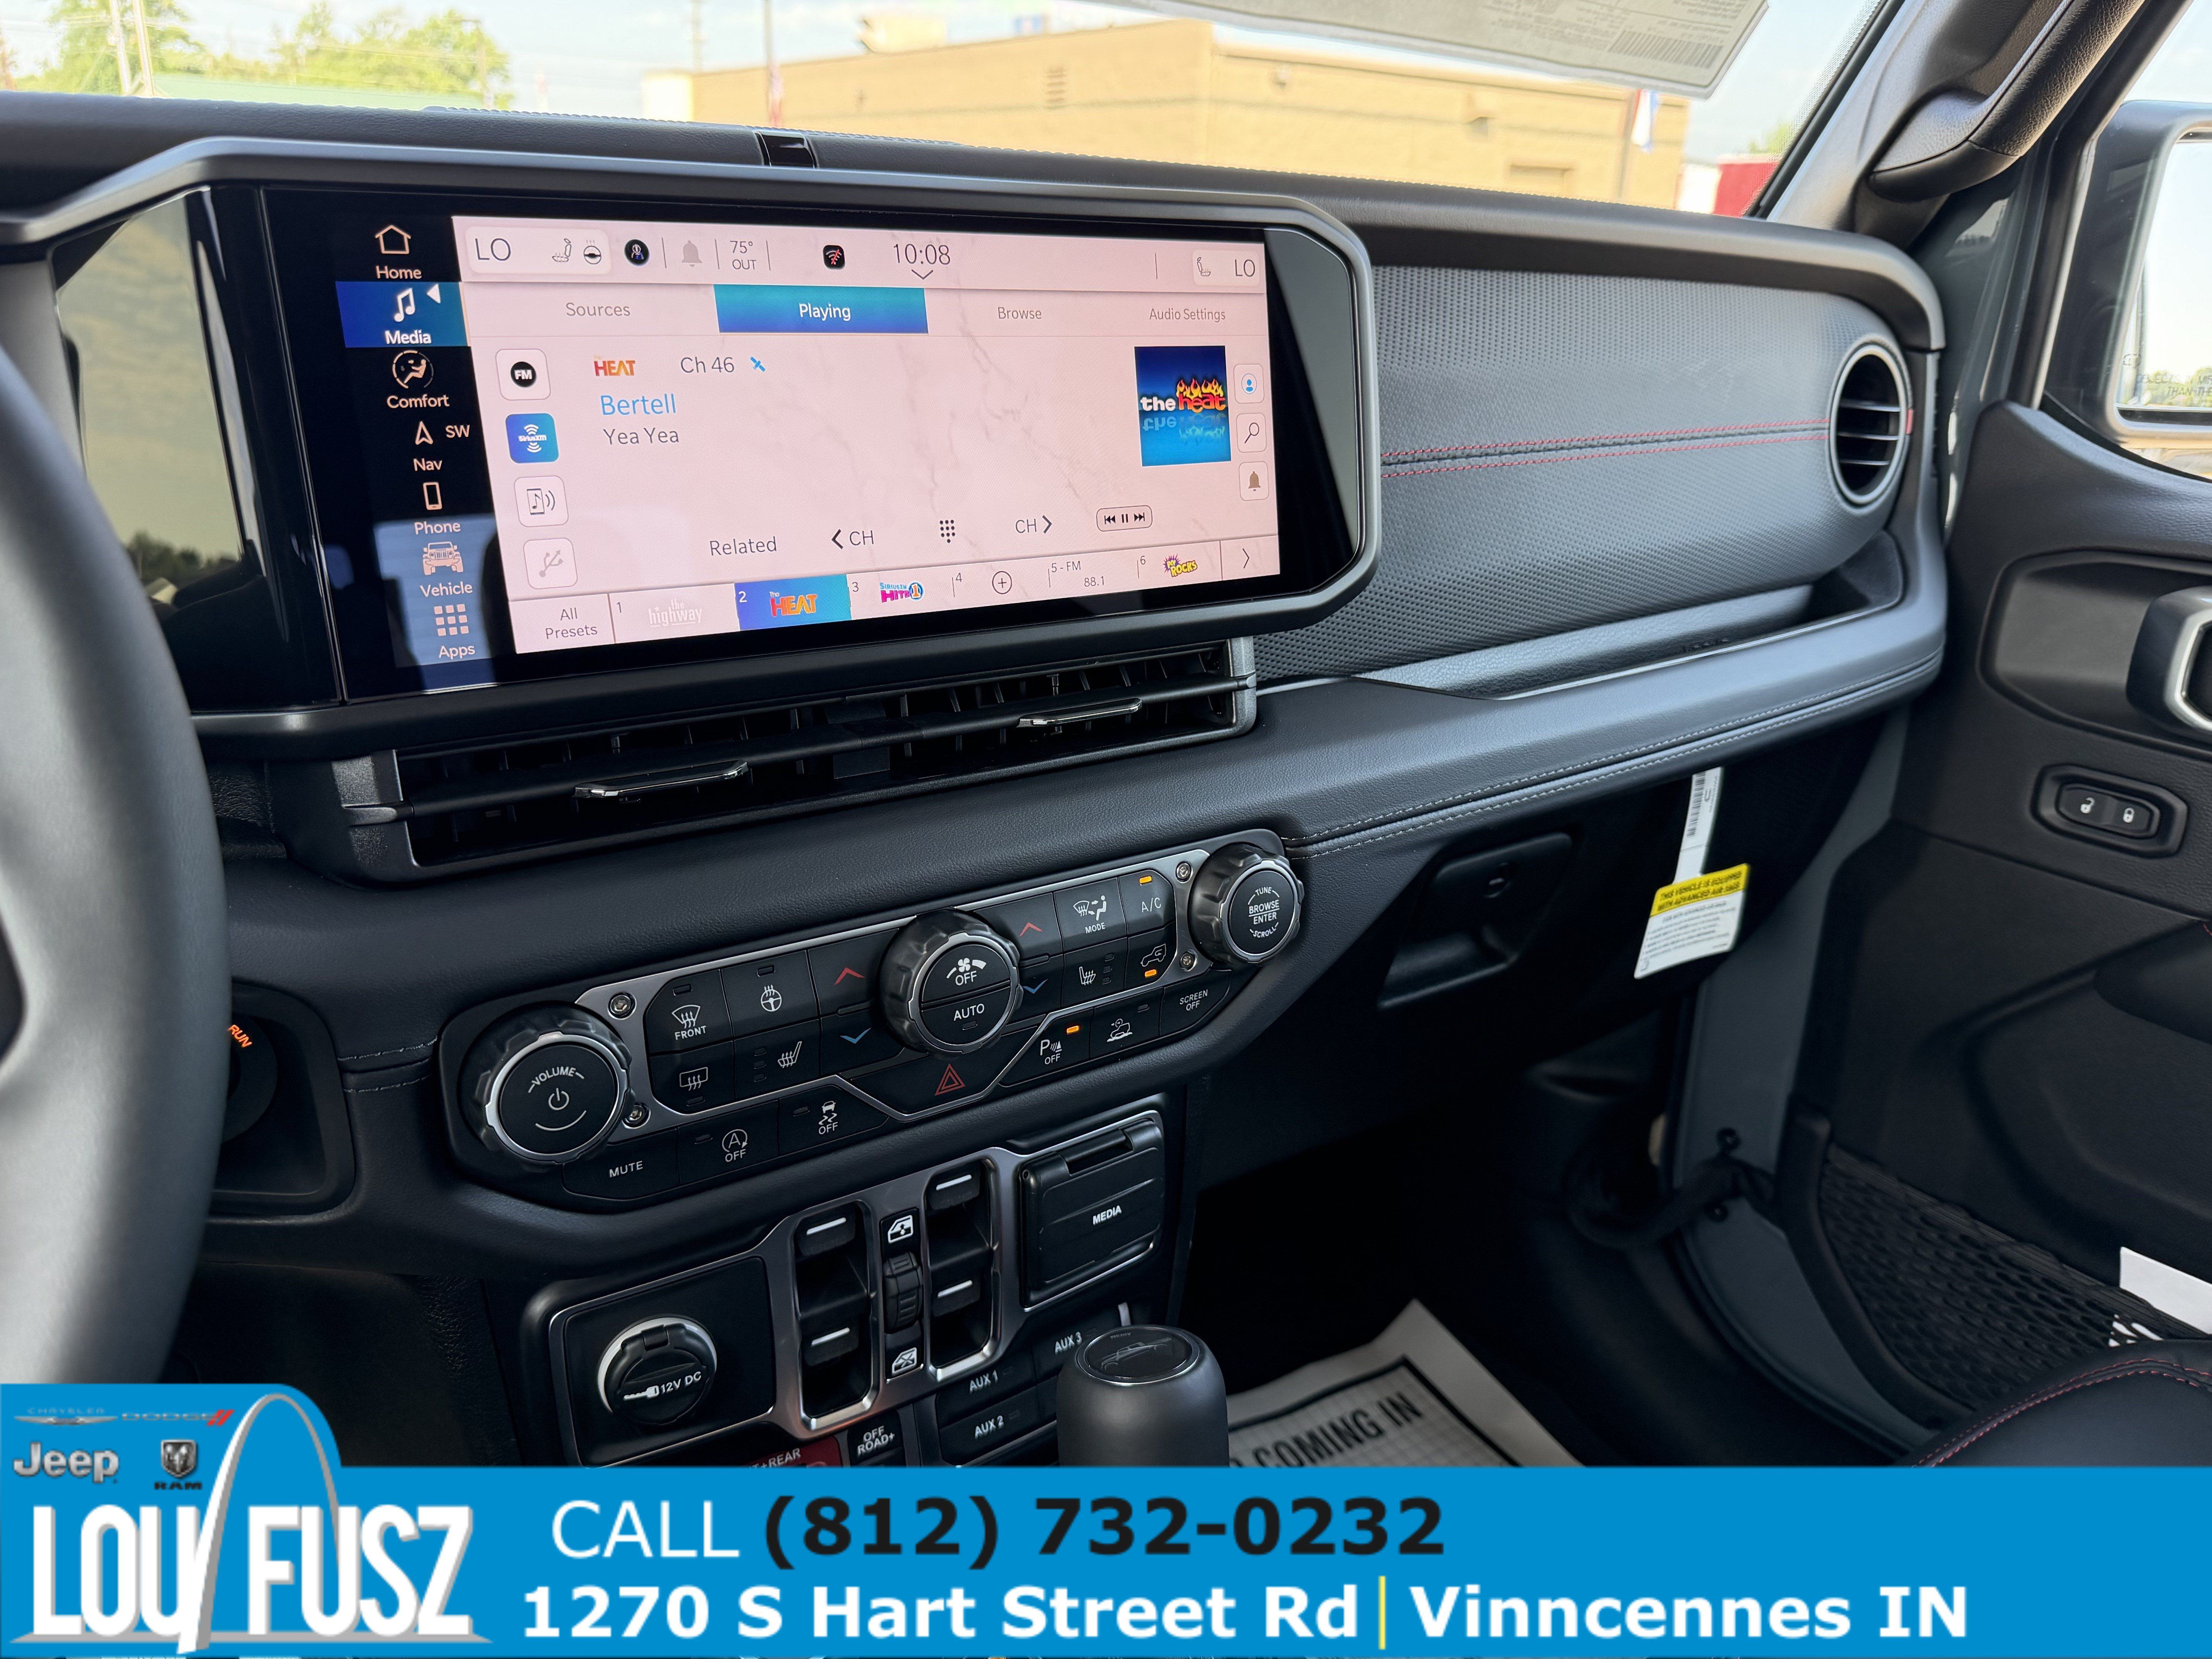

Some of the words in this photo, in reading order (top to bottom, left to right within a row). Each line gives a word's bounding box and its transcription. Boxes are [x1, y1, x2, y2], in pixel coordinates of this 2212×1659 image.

[475, 238, 511, 261] LO
[730, 241, 754, 254] 75°
[893, 243, 951, 266] 10:08
[732, 259, 756, 270] OUT
[1235, 259, 1255, 278] LO
[376, 266, 422, 280] Home
[566, 302, 630, 317] Sources
[799, 303, 851, 321] Playing
[998, 306, 1042, 320] Browse
[1149, 308, 1181, 321] Audio
[1184, 308, 1226, 323] Settings
[385, 330, 432, 344] Media
[594, 360, 636, 376] HEAT
[680, 356, 706, 373] Ch
[711, 357, 735, 373] 46
[514, 369, 532, 380] FM
[387, 394, 450, 409] Comfort
[601, 393, 676, 416] Bertell
[1140, 396, 1176, 411] the
[1177, 390, 1226, 413] heat
[445, 425, 471, 438] SW
[603, 429, 639, 445] Yea
[644, 428, 679, 443] Yea
[414, 458, 443, 472] Nav
[414, 521, 461, 536] Phone
[1015, 518, 1038, 534] CH
[849, 530, 874, 546] CH
[709, 537, 778, 556] Related
[1051, 563, 1057, 572] 5
[1066, 561, 1081, 571] FM
[1140, 556, 1146, 565] 6
[1170, 560, 1198, 577] ROCKS
[955, 572, 962, 582] 4
[1084, 575, 1104, 587] 88.1
[421, 582, 473, 597] Vehicle
[852, 582, 859, 592] 3
[739, 591, 747, 603] 2
[617, 602, 622, 613] 1
[770, 594, 818, 617] HEAT
[560, 607, 578, 622] All
[649, 606, 702, 627] highway
[545, 624, 598, 640] Presets
[439, 644, 476, 660] Apps
[1255, 886, 1272, 896] TUNE
[1141, 897, 1161, 914] A/C
[1249, 899, 1280, 914] BROWSE
[1253, 912, 1277, 924] ENTER
[1085, 922, 1106, 935] MODE
[1253, 925, 1277, 939] SCROLL
[955, 969, 977, 986] OFF
[1179, 989, 1209, 1006] SCREEN
[1186, 1000, 1201, 1011] OFF
[953, 1003, 985, 1021] AUTO
[228, 1024, 252, 1048] RUN
[675, 1025, 707, 1040] FRONT
[1040, 1039, 1051, 1056] P
[1044, 1053, 1061, 1066] OFF
[532, 1066, 576, 1087] VOLUME
[818, 1120, 838, 1136] OFF
[725, 1147, 747, 1163] OFF
[609, 1161, 644, 1178] MUTE
[1093, 1205, 1122, 1225] MEDIA
[1054, 1334, 1074, 1355] AUX
[1075, 1331, 1083, 1346] 3
[659, 1379, 682, 1395] 12V
[684, 1370, 702, 1387] DC
[969, 1374, 989, 1393] AUX
[992, 1370, 998, 1384] 1
[863, 1425, 885, 1443] OFF
[975, 1419, 996, 1439] AUX
[997, 1415, 1005, 1429] 2
[1253, 1408, 1384, 1467] COMING
[1377, 1392, 1423, 1427] IN
[857, 1432, 895, 1456] ROAD+
